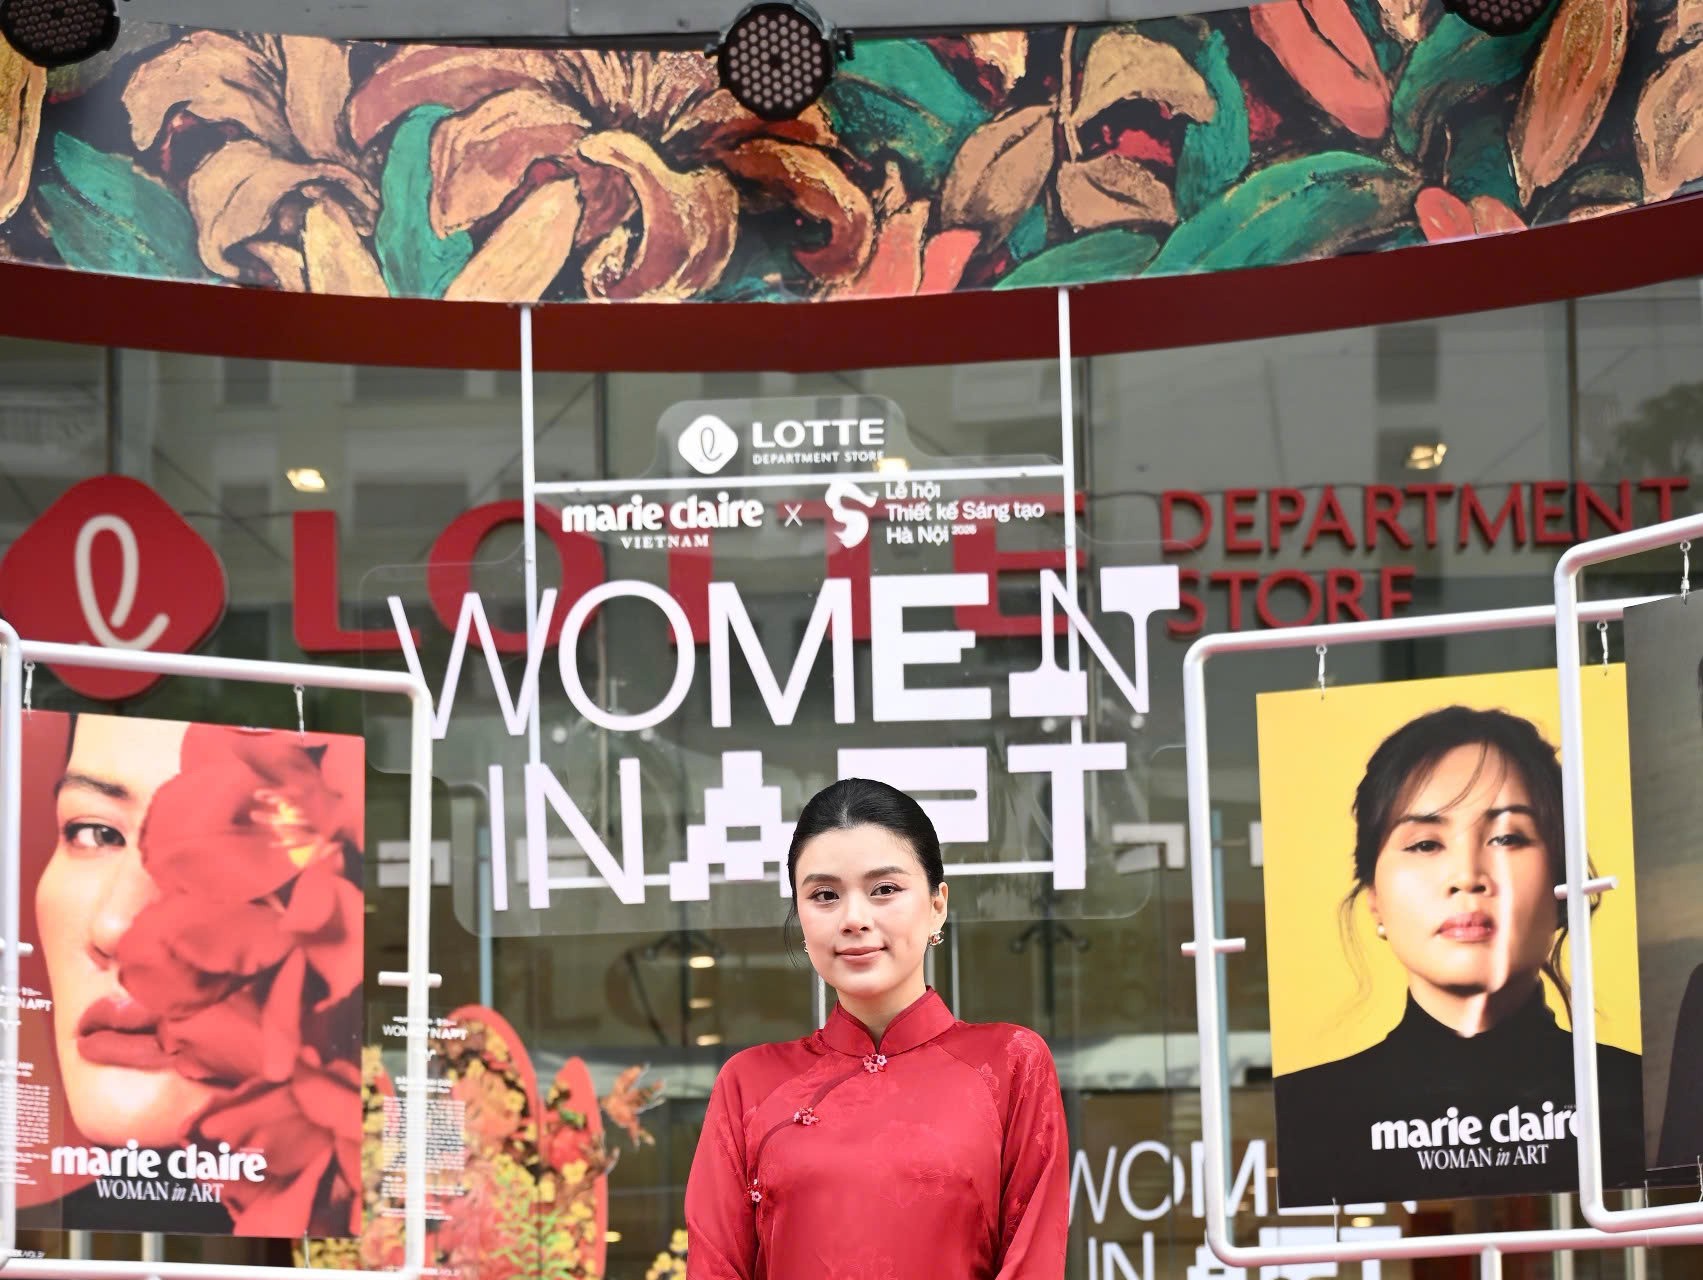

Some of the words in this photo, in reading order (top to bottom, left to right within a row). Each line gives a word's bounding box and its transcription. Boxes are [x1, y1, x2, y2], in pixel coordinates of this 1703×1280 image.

[752, 418, 885, 448] LOTTE
[752, 451, 840, 465] DEPARTMENT
[844, 450, 885, 463] STORE
[561, 494, 665, 533] marie
[669, 491, 765, 530] claire
[962, 500, 1011, 523] Sáng
[1014, 501, 1046, 521] tạo
[1160, 477, 1691, 554] DEPARTMENT
[621, 534, 710, 549] VIETNAM
[886, 525, 913, 545] Hà
[917, 525, 950, 546] Nội
[1166, 565, 1417, 638] STORE
[388, 564, 1181, 740] WOMEN
[489, 762, 646, 911] IN
[1371, 1106, 1484, 1151] marie
[51, 1138, 162, 1179] marie
[167, 1141, 268, 1183] claire
[1416, 1147, 1493, 1171] WOMAN
[1495, 1149, 1512, 1167] in
[1513, 1143, 1550, 1166] ART
[96, 1179, 170, 1201] WOMAN
[171, 1182, 187, 1202] in
[188, 1182, 225, 1203] ART
